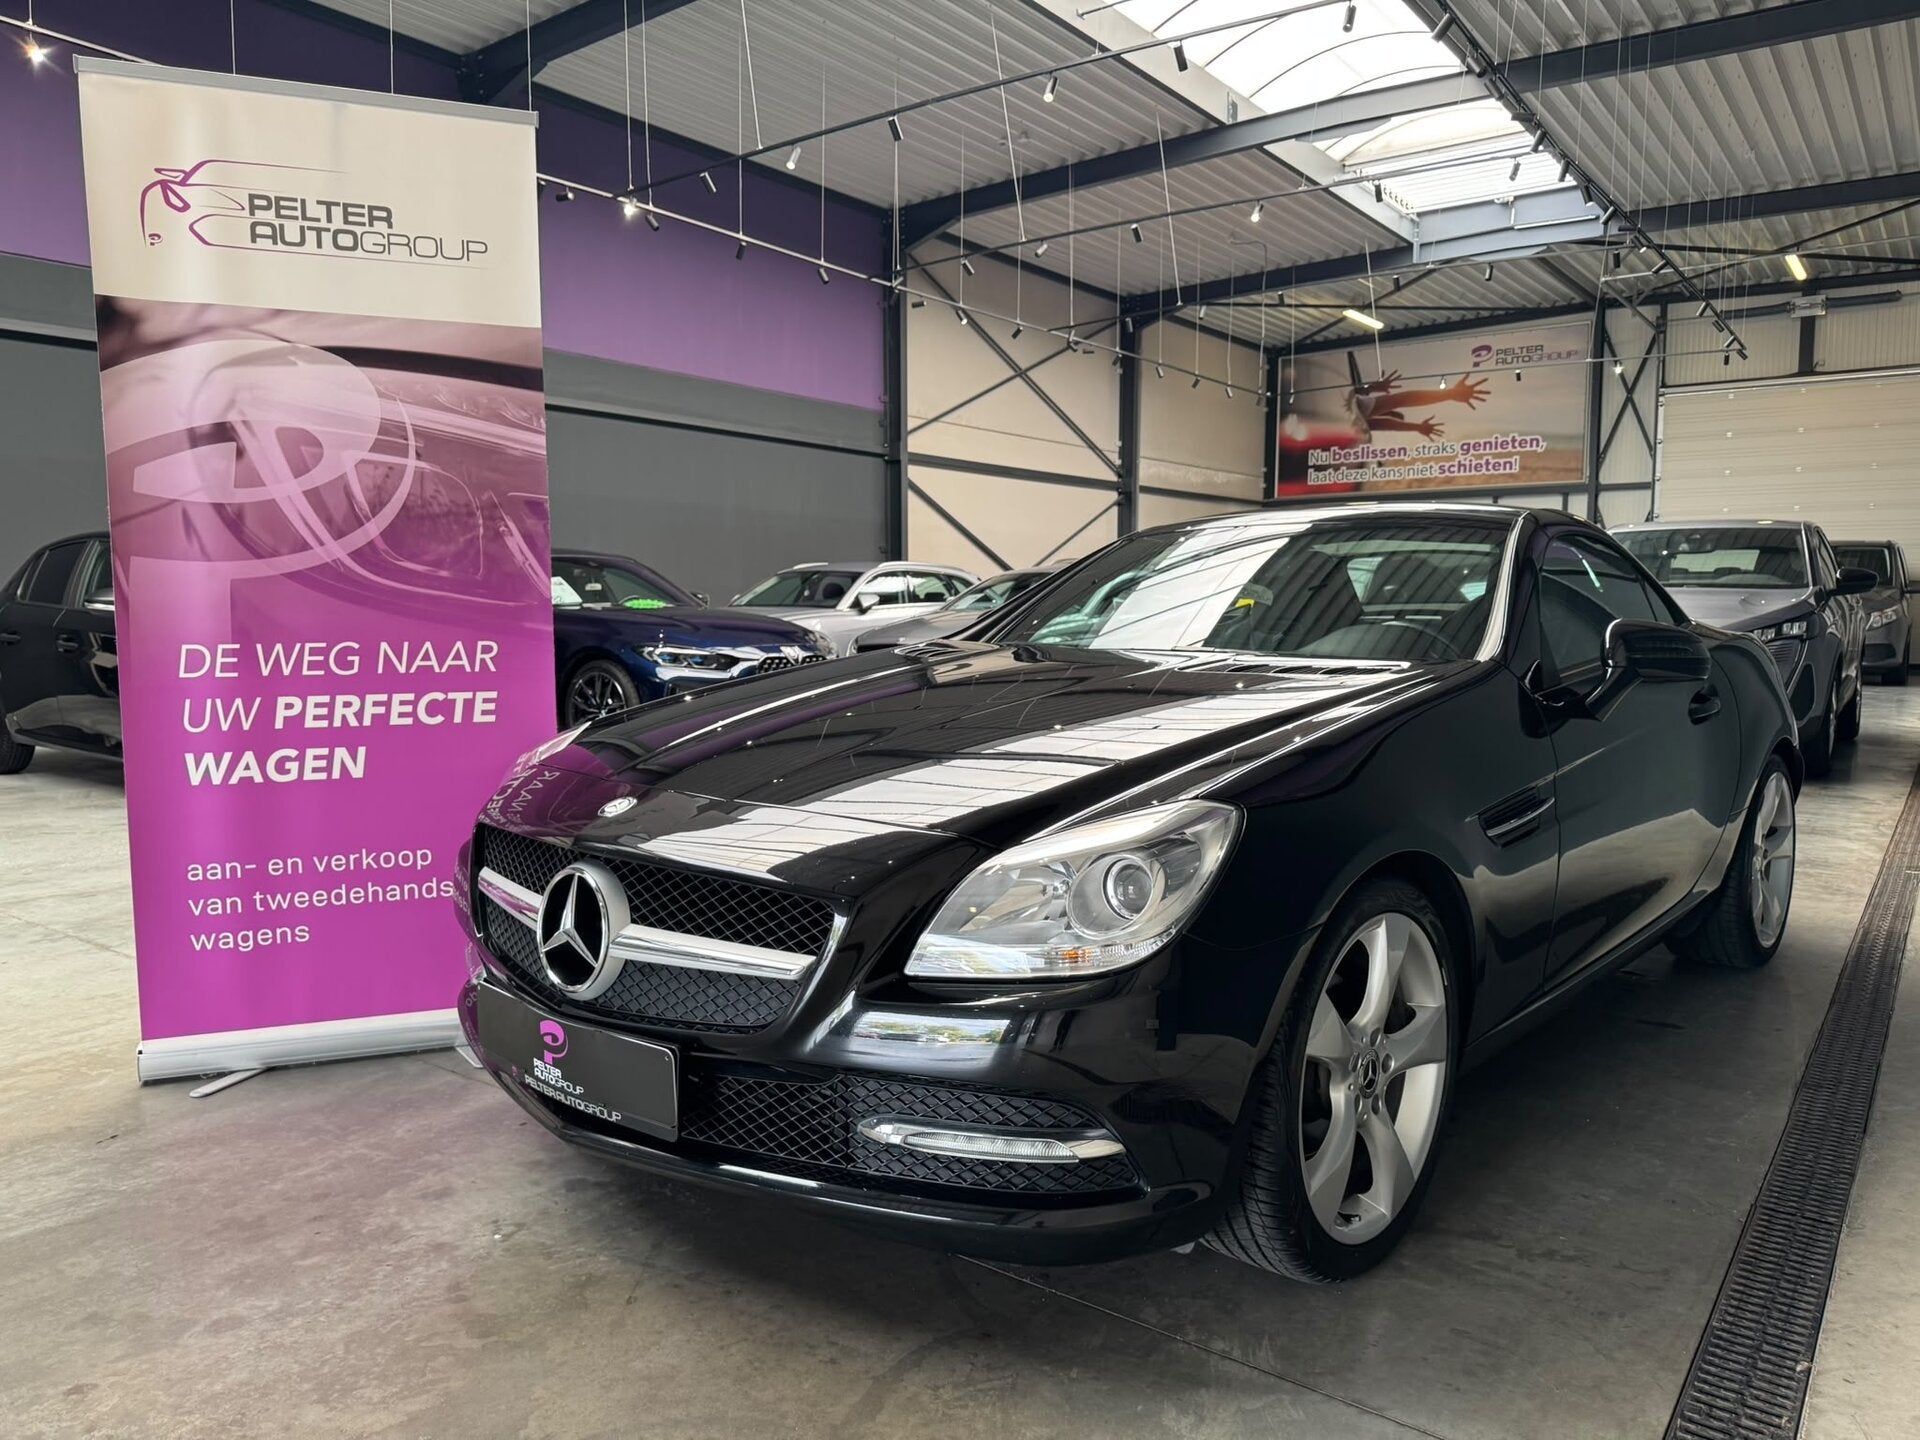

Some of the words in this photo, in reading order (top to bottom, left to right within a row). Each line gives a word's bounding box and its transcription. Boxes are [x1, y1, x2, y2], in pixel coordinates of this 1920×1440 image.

[248, 193, 394, 229] PELTER
[250, 221, 489, 262] AUTOGROUP
[1495, 344, 1544, 357] PELTER
[1495, 349, 1579, 366] AUTOGROUP
[1309, 450, 1329, 466] Nu
[1332, 444, 1412, 462] beslissen,
[1414, 441, 1456, 456] straks
[1459, 435, 1546, 455] genieten,
[1308, 468, 1334, 484] laat
[1335, 465, 1368, 481] deze
[1370, 463, 1403, 479] kans
[1406, 462, 1434, 477] niet
[1437, 457, 1519, 475] schieten!
[178, 643, 240, 679] DE
[255, 641, 360, 677] WEG
[377, 640, 499, 674] NAAR
[183, 697, 262, 733] UW
[274, 691, 498, 730] PERFECTE
[184, 746, 367, 786] WAGEN
[187, 861, 257, 881] aan-
[268, 857, 303, 876] en
[313, 848, 432, 873] verkoop
[188, 896, 242, 916] van
[253, 877, 454, 912] tweedehands
[190, 925, 310, 952] wagens
[533, 1057, 562, 1079] PELTER
[534, 1067, 585, 1095] AUTOGROUP
